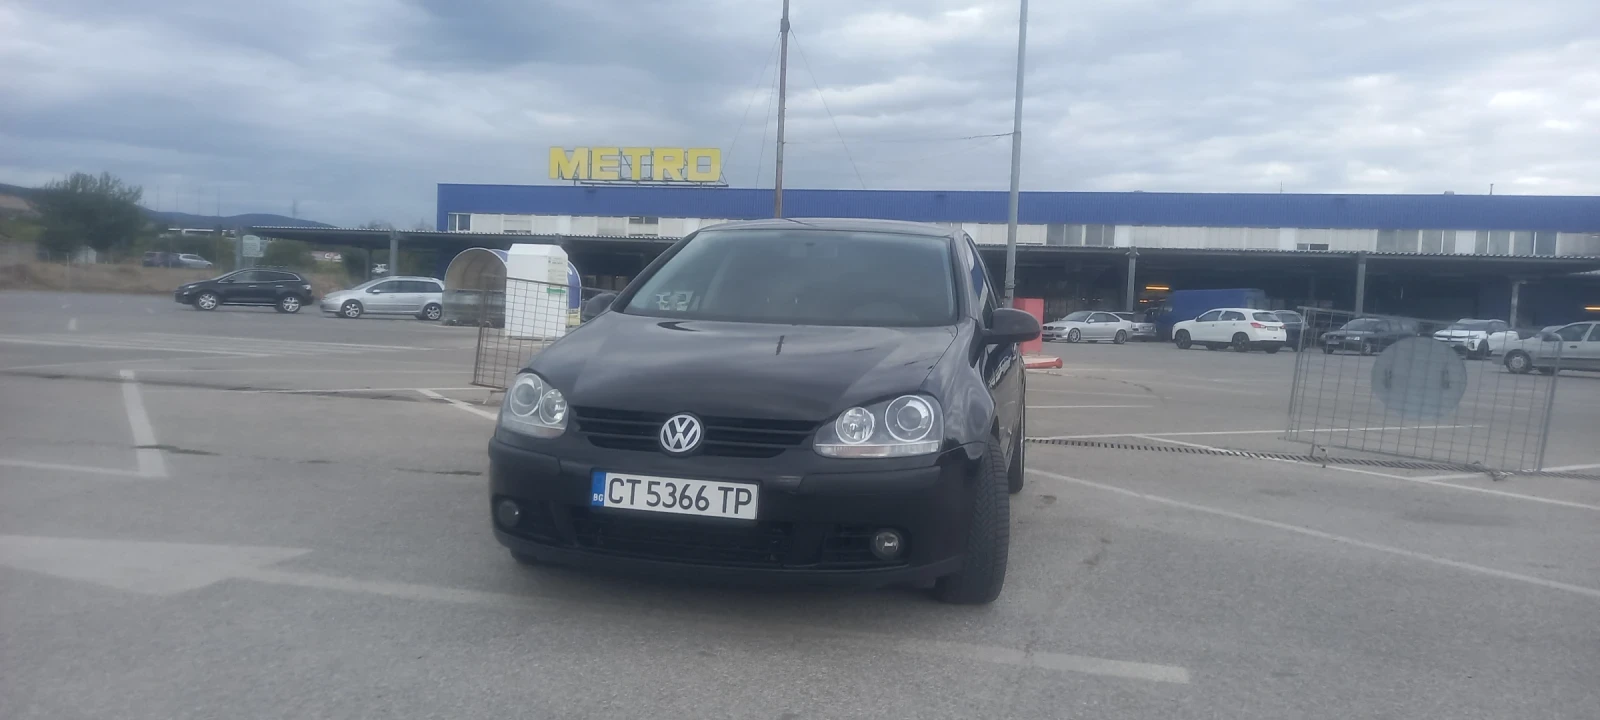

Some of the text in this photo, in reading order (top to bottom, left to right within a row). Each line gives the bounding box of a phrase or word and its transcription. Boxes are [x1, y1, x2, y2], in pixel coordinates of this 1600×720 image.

[548, 146, 722, 182] METRO
[593, 493, 604, 502] BG
[608, 477, 753, 515] CT 5366 TP
